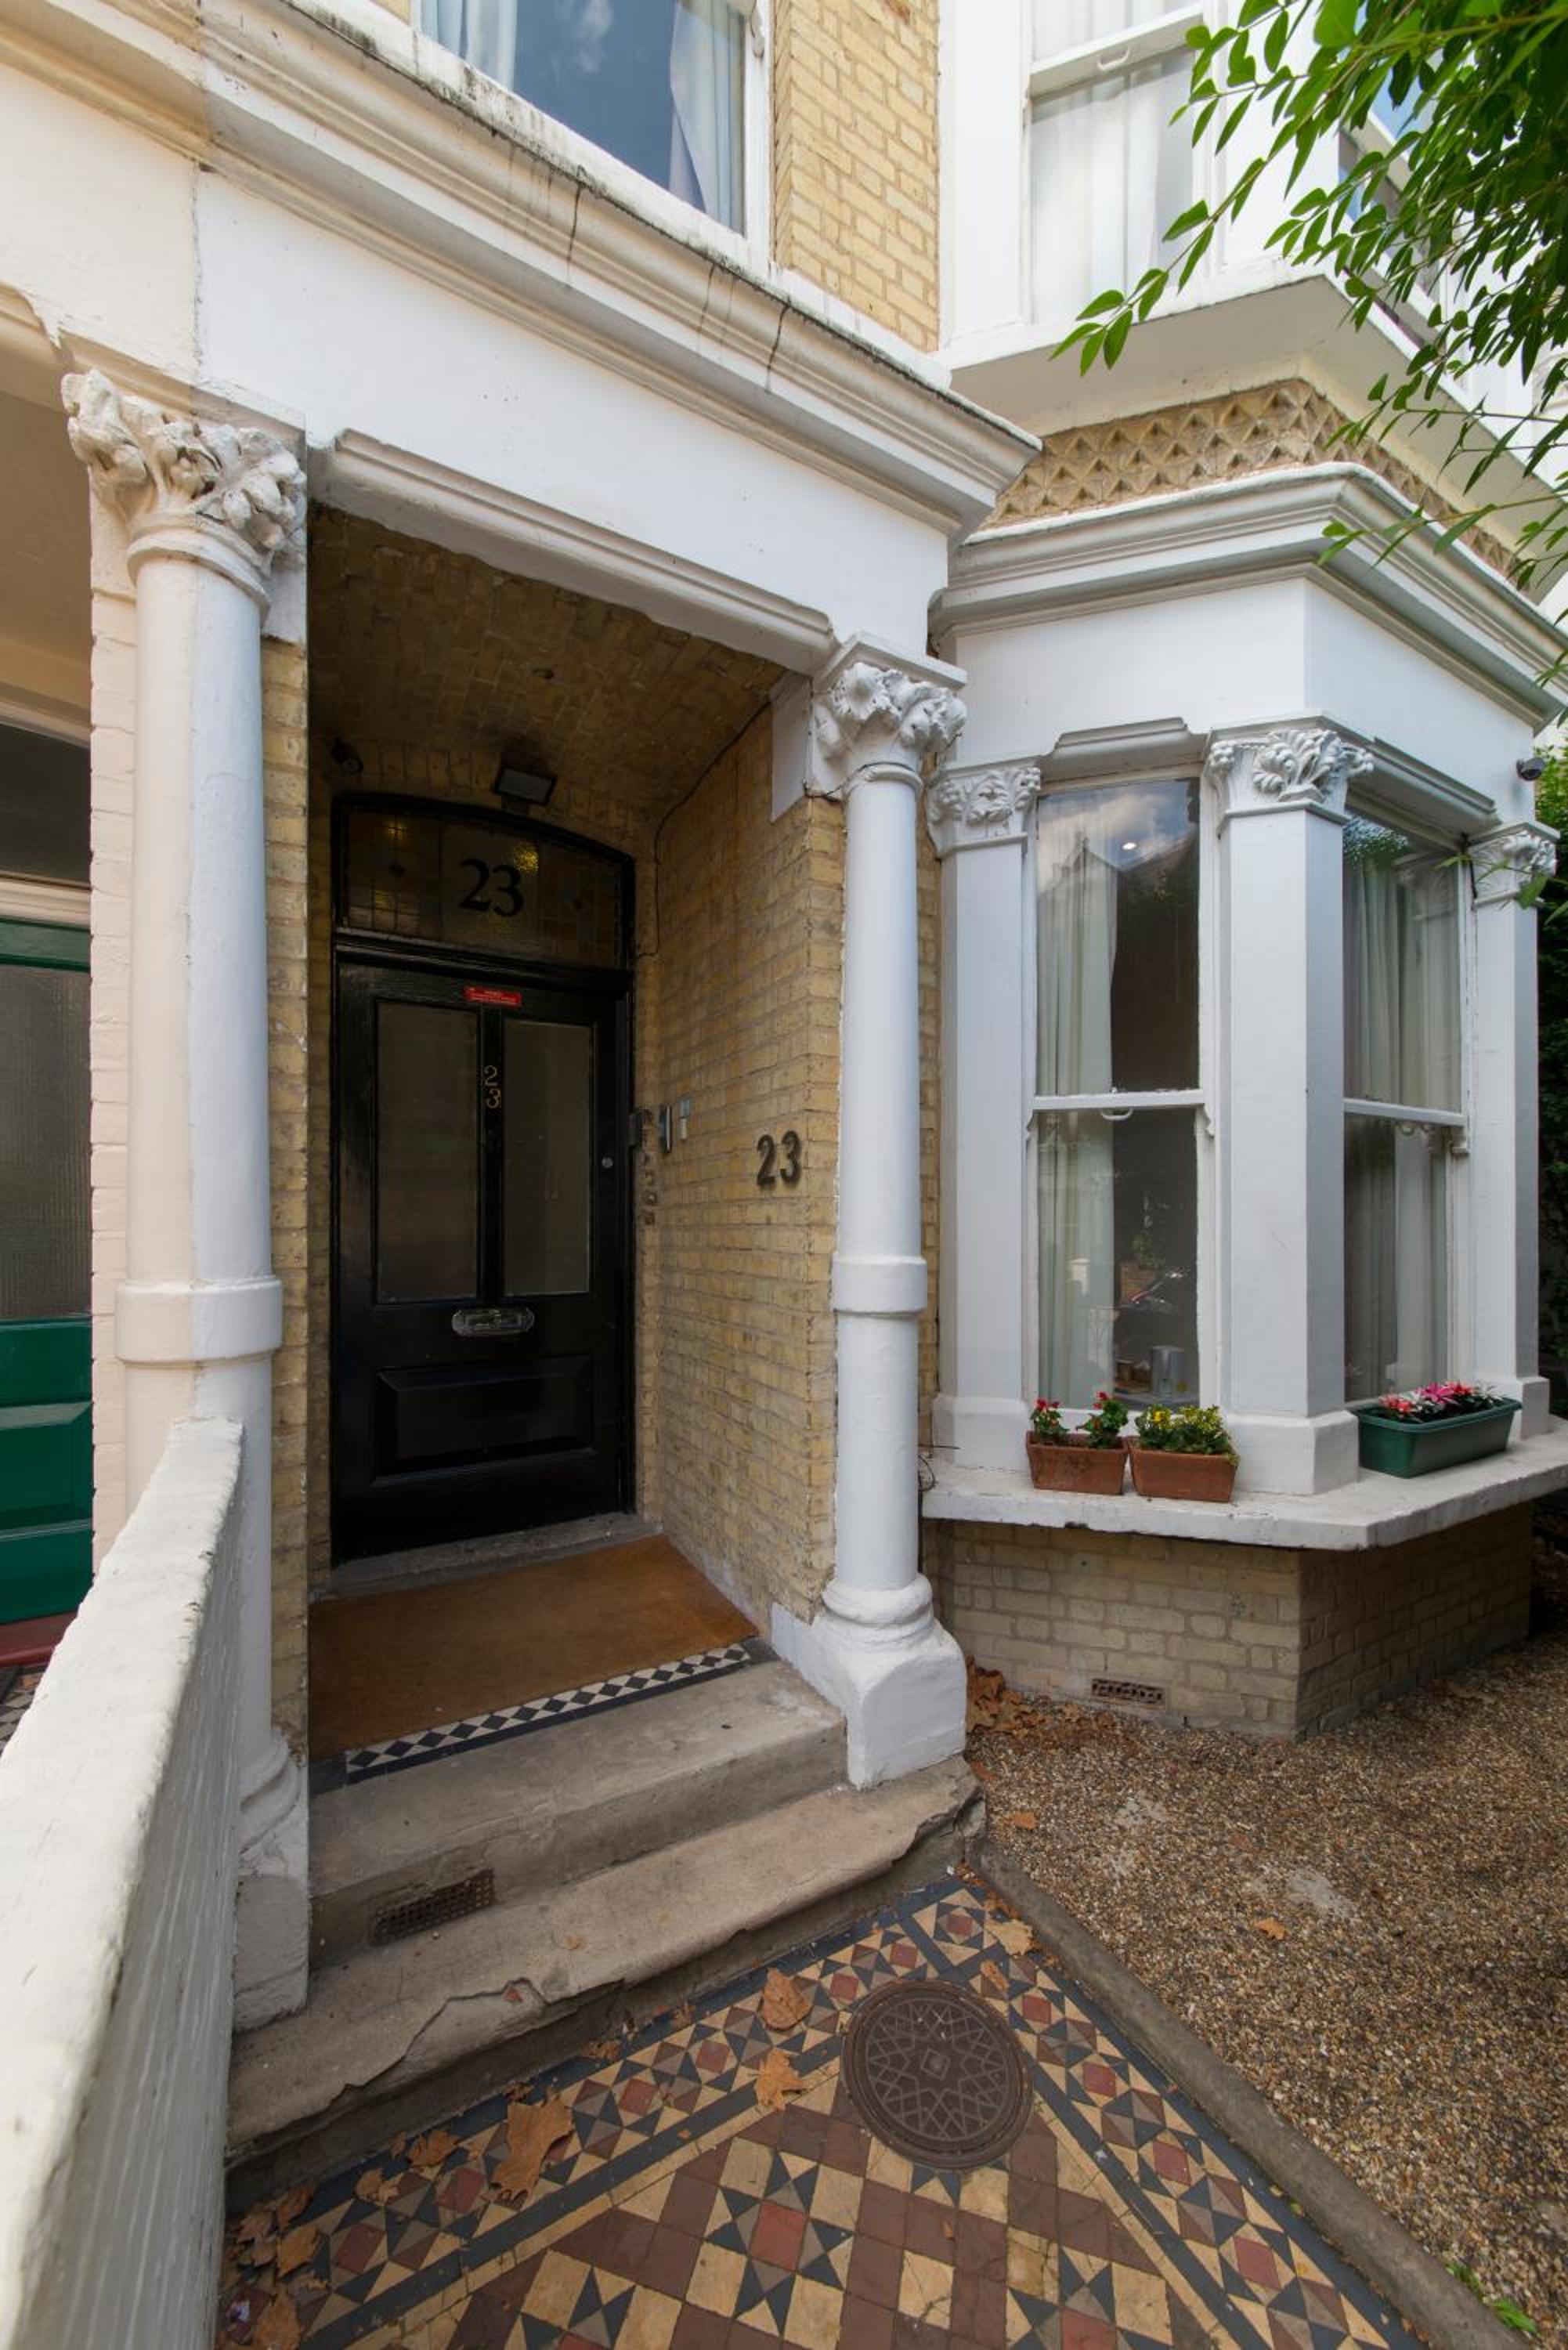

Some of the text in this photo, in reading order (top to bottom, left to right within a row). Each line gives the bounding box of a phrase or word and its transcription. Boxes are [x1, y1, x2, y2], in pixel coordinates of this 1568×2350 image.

[460, 859, 524, 916] 23
[483, 1065, 501, 1108] 23
[756, 1130, 802, 1186] 23
